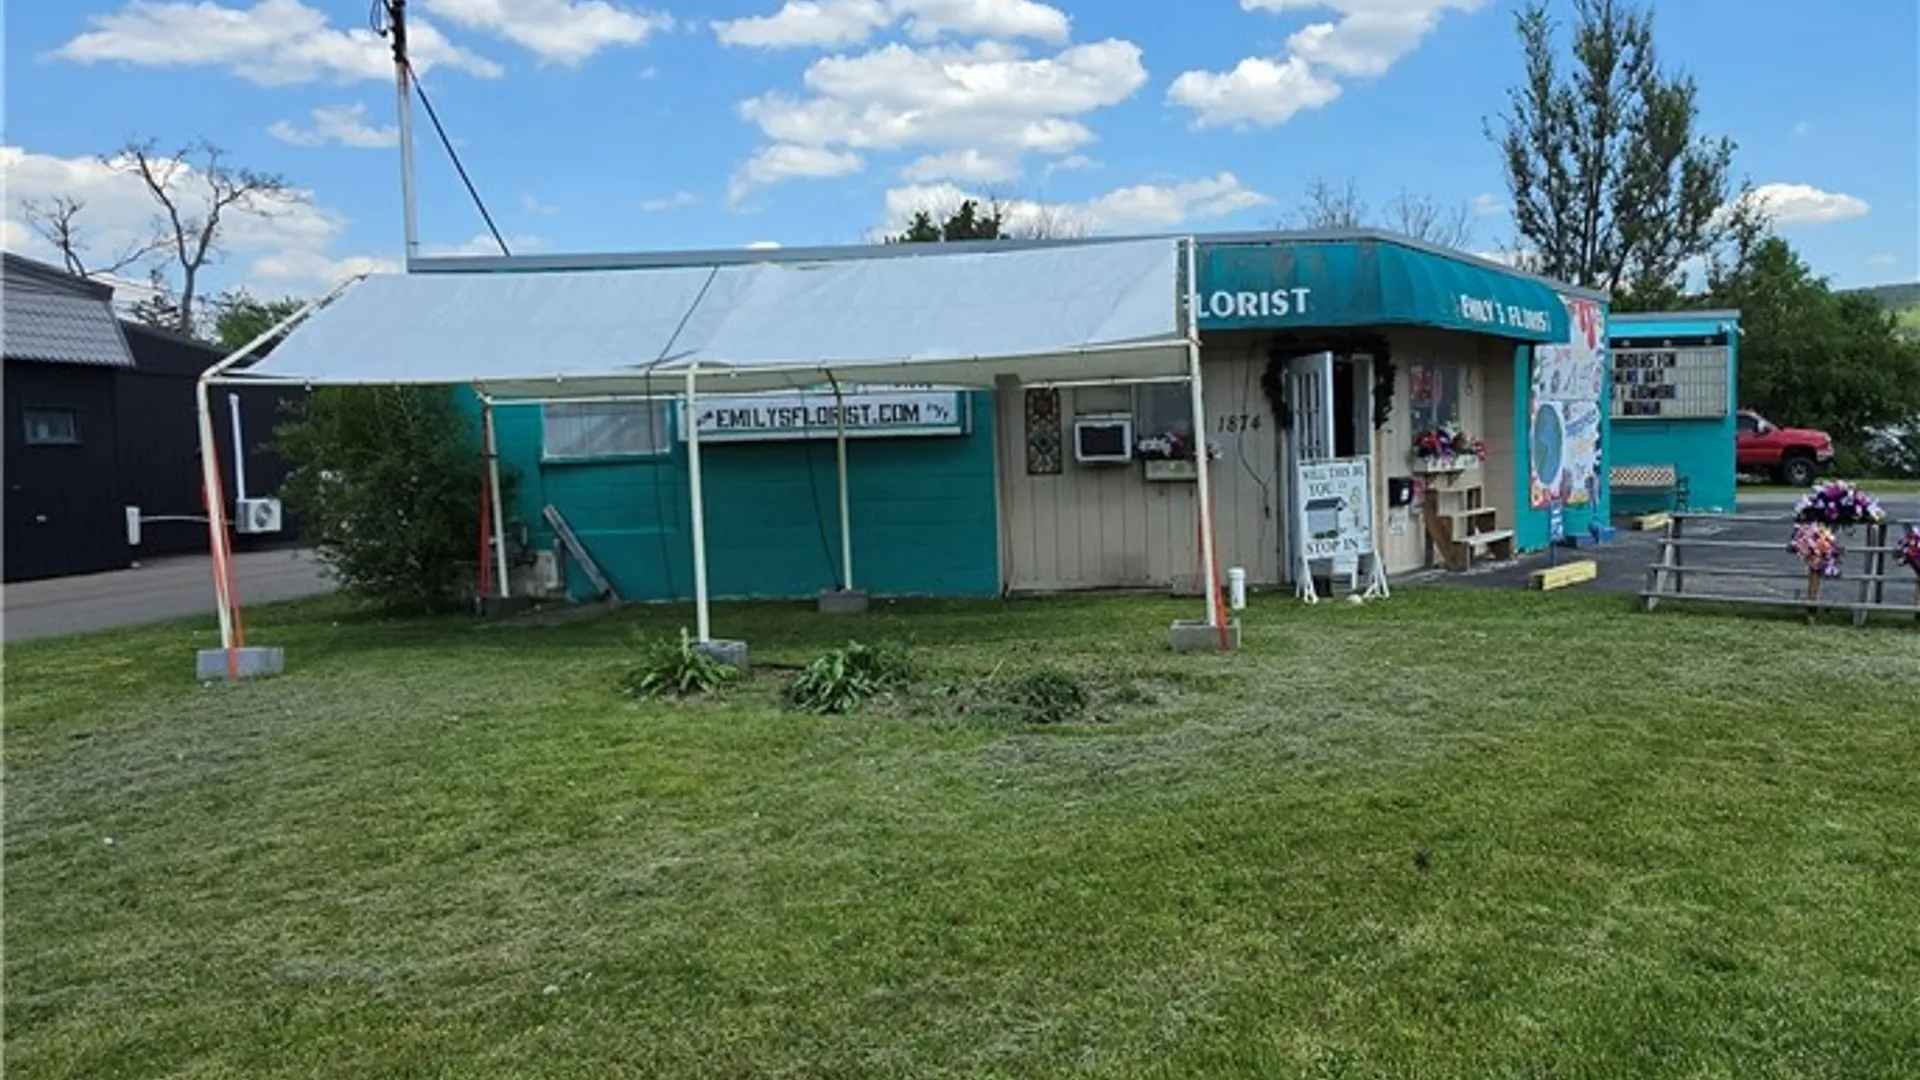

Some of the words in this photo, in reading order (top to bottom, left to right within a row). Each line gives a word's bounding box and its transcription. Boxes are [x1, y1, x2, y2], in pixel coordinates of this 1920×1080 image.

[1217, 413, 1263, 433] 1874
[1306, 540, 1339, 554] STOP
[1343, 538, 1359, 551] IN
